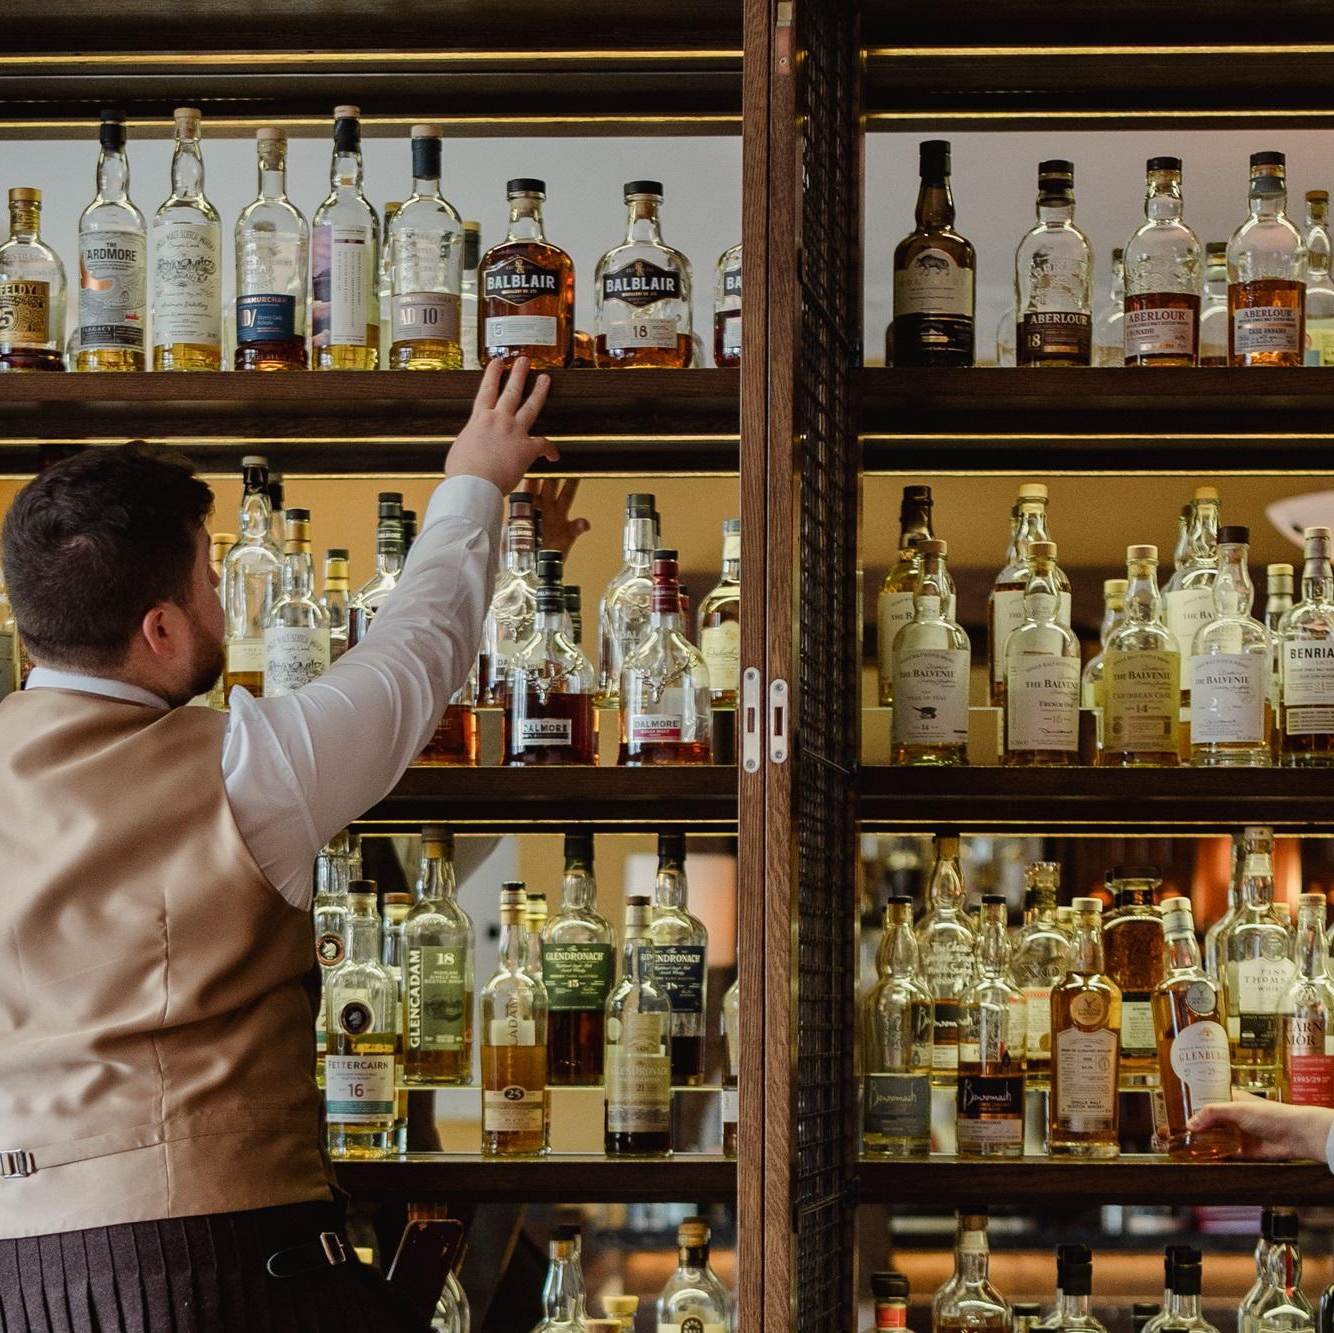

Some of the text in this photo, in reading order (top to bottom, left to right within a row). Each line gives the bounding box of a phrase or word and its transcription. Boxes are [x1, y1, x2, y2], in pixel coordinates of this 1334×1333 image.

[87, 249, 136, 262] ARDMORE
[486, 275, 555, 291] BALBLAIR
[605, 277, 675, 292] BALBLAIR
[423, 307, 437, 325] 10
[1128, 310, 1186, 322] ABERLOUR
[1243, 309, 1292, 318] ABERLOUR
[1030, 314, 1088, 326] ABERLOUR
[633, 325, 648, 338] 18
[1027, 333, 1041, 347] 18
[1136, 703, 1149, 713] 14
[523, 723, 569, 733] DALMORE
[633, 720, 680, 729] DALMORE
[436, 952, 455, 966] 18
[545, 951, 604, 962] GLENDRONACH
[409, 949, 422, 1049] GLENCADAM
[327, 1060, 388, 1070] FETTERCAIRN
[348, 1083, 364, 1098] 16
[507, 1088, 523, 1099] 25
